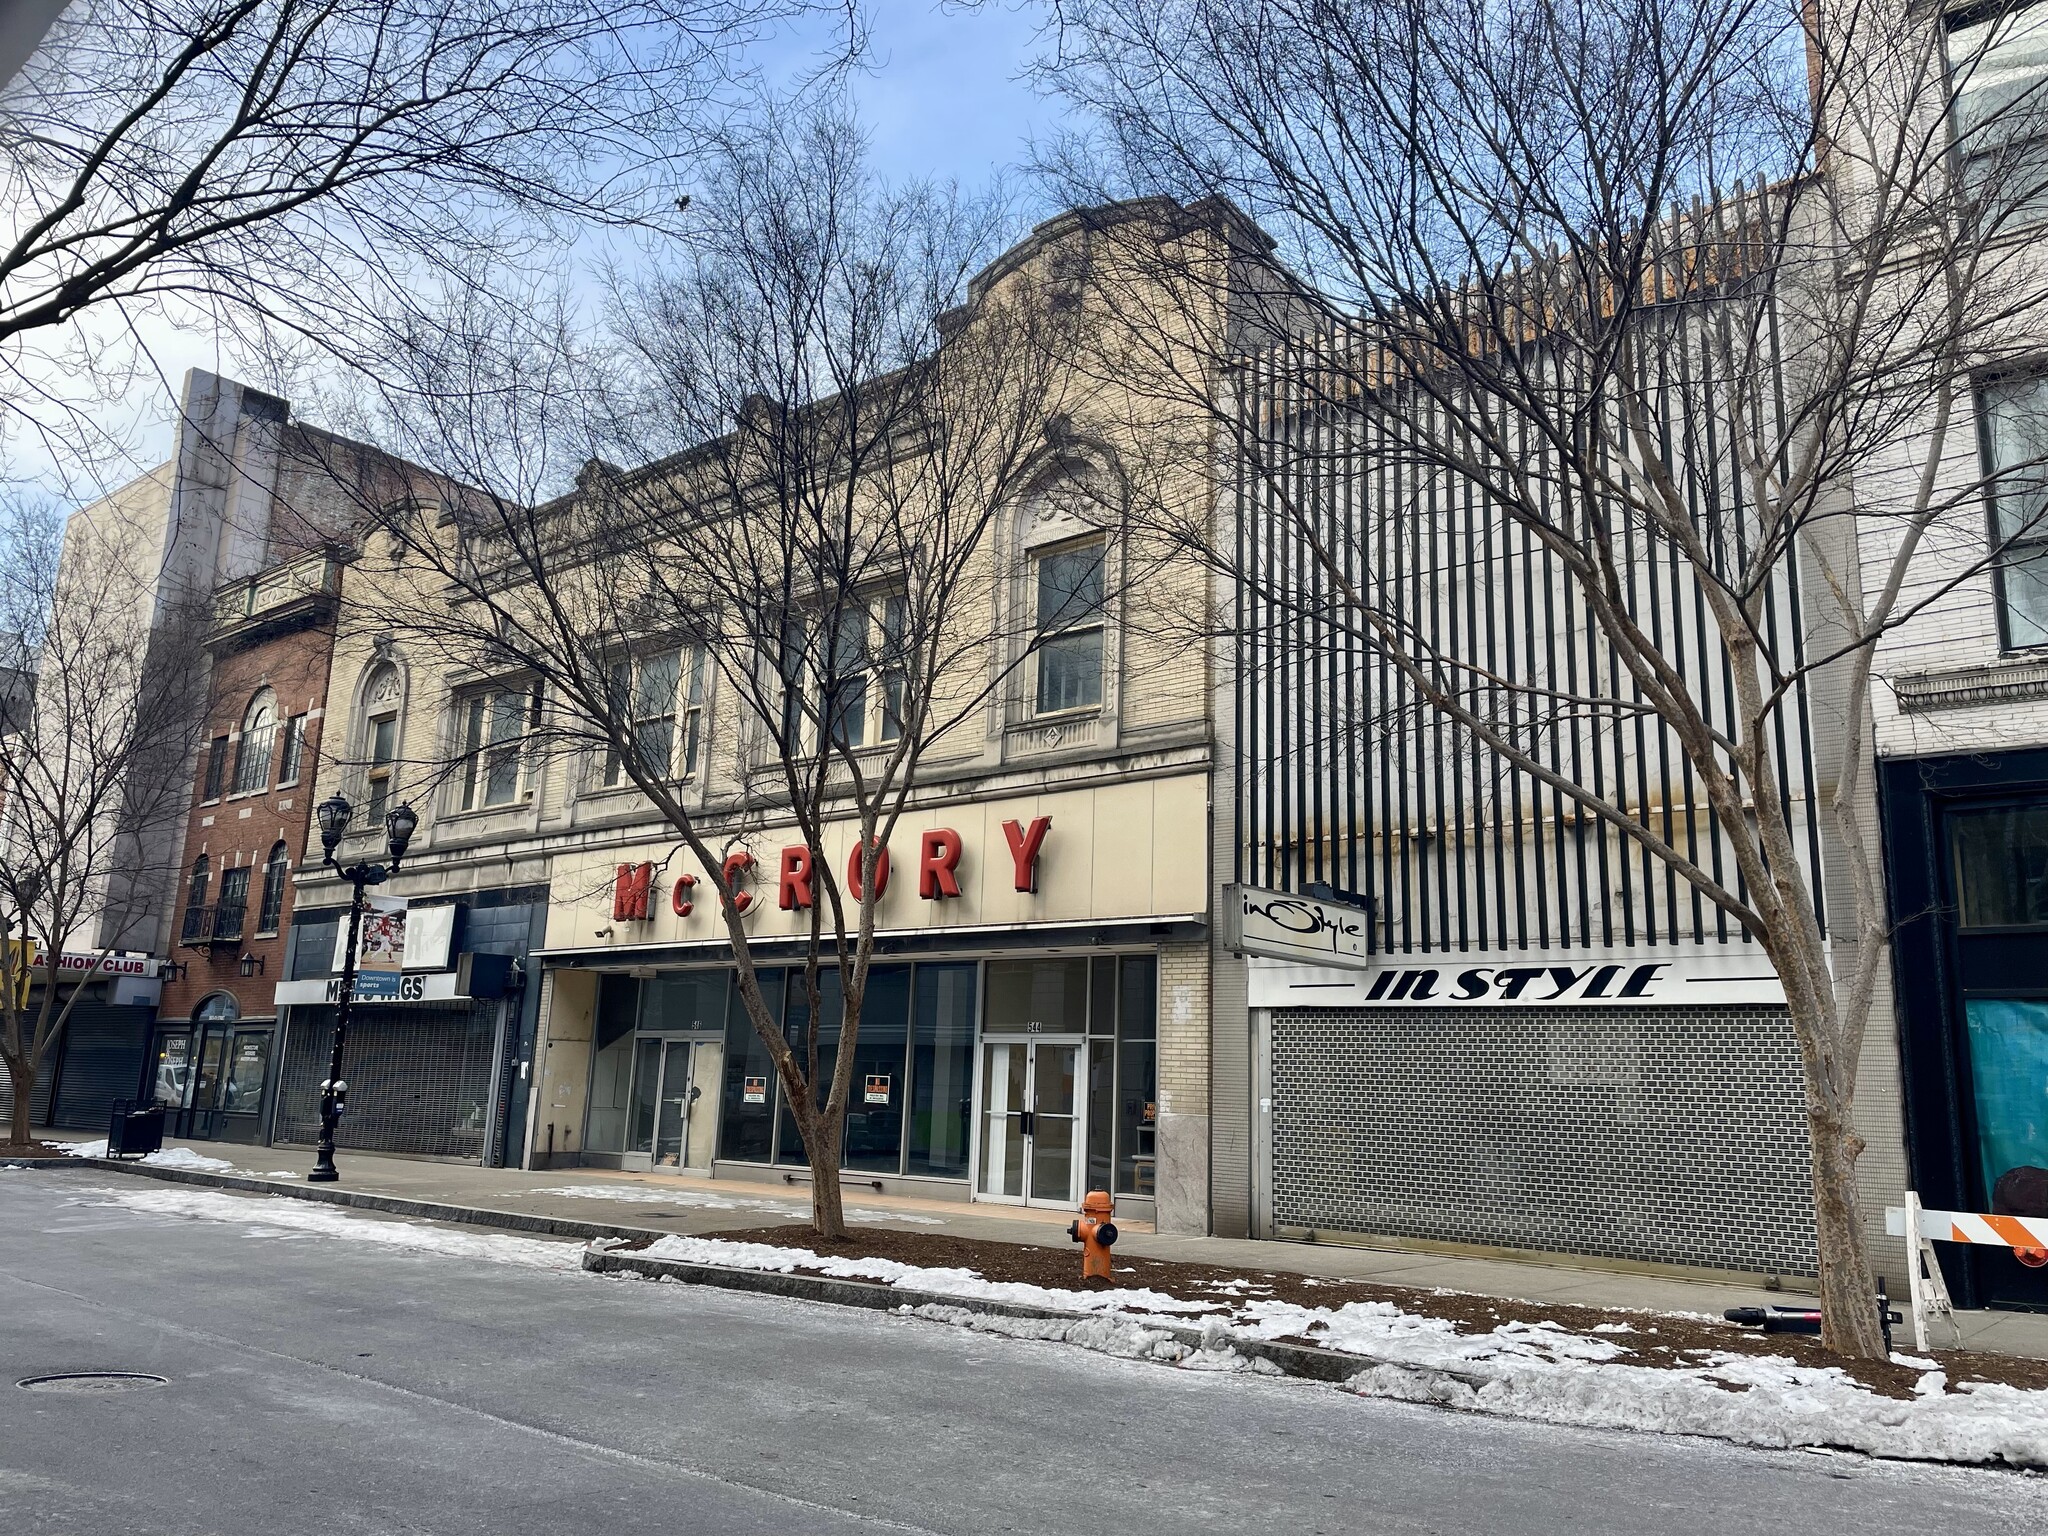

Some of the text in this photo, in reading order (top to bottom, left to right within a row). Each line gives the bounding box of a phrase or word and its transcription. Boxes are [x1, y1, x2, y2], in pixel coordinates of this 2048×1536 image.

[102, 959, 144, 973] CLUB
[361, 974, 391, 982] Downtown
[1448, 963, 1673, 1001] STYLE
[1028, 1022, 1041, 1032] 544
[167, 1040, 187, 1050] JOSEPH
